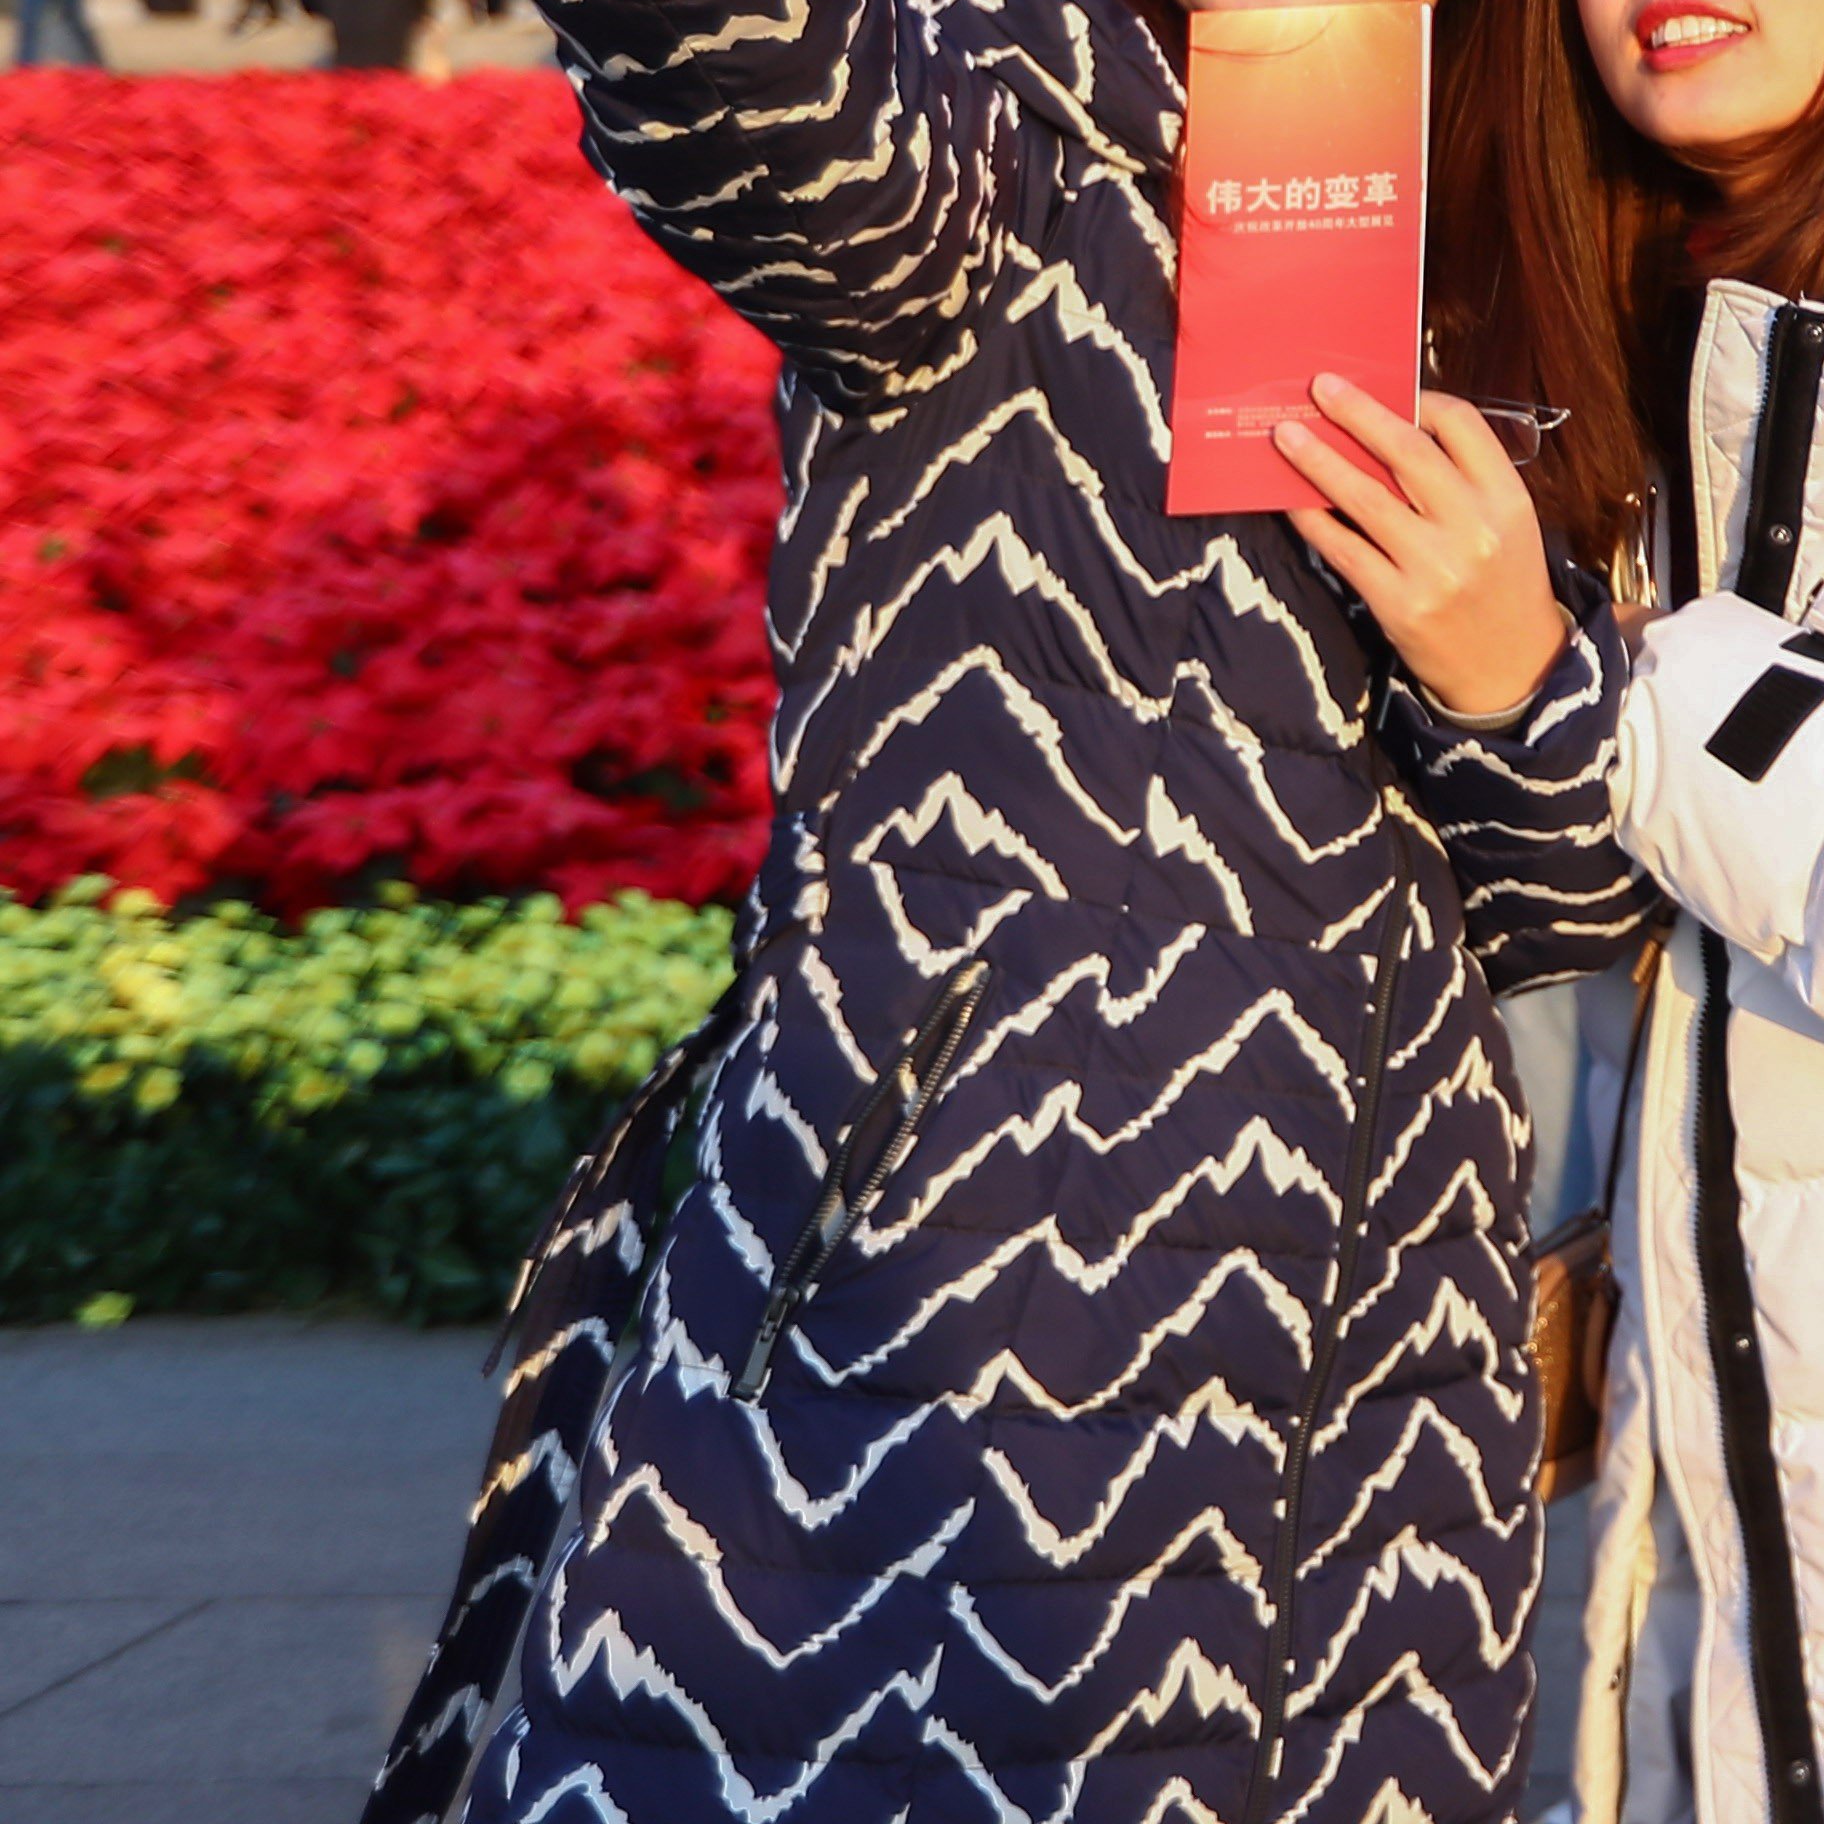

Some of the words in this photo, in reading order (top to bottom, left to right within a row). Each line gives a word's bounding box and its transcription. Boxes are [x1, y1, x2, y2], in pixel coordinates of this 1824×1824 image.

[1206, 172, 1398, 215] 伟大的变革
